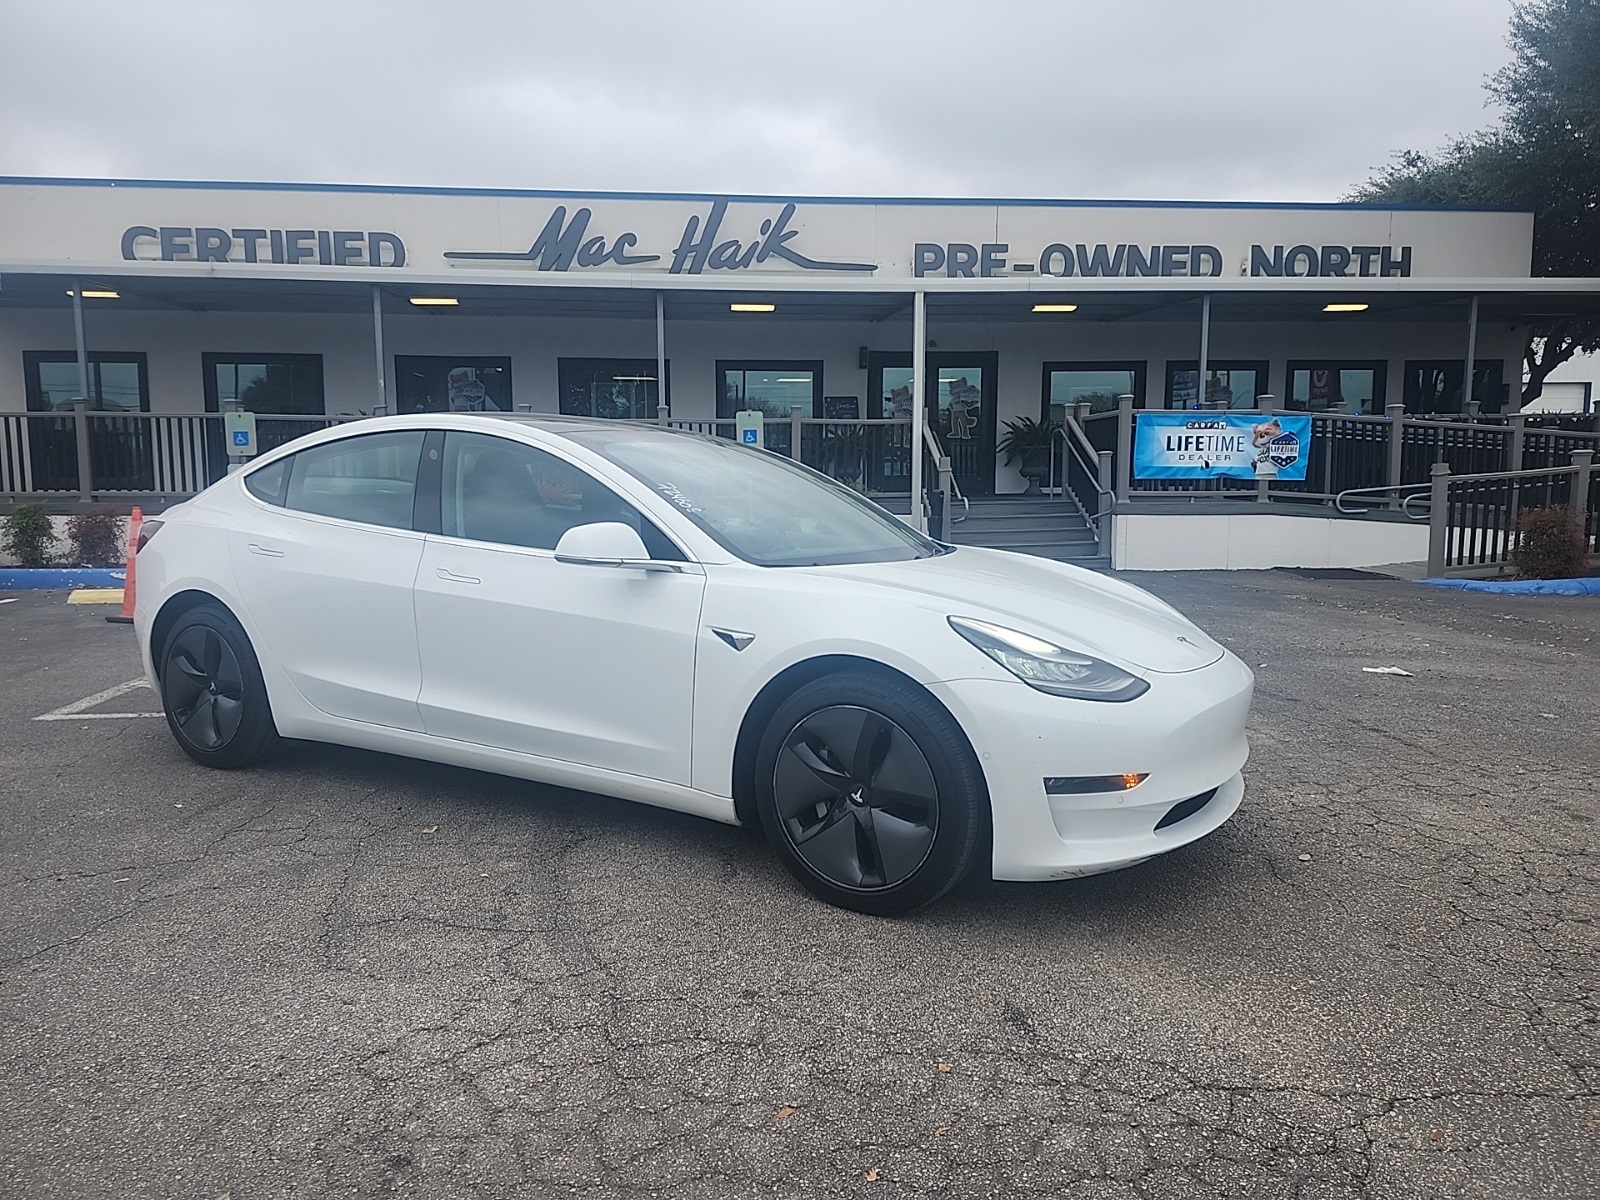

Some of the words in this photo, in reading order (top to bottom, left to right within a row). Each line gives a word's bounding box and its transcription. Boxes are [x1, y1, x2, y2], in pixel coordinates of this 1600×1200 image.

[121, 225, 406, 268] CERTIFIED
[443, 206, 660, 272] Mac
[668, 195, 879, 275] Haik
[914, 243, 1223, 278] PRE-OWNED
[1250, 244, 1412, 277] NORTH
[1166, 435, 1246, 453] LIFETIME
